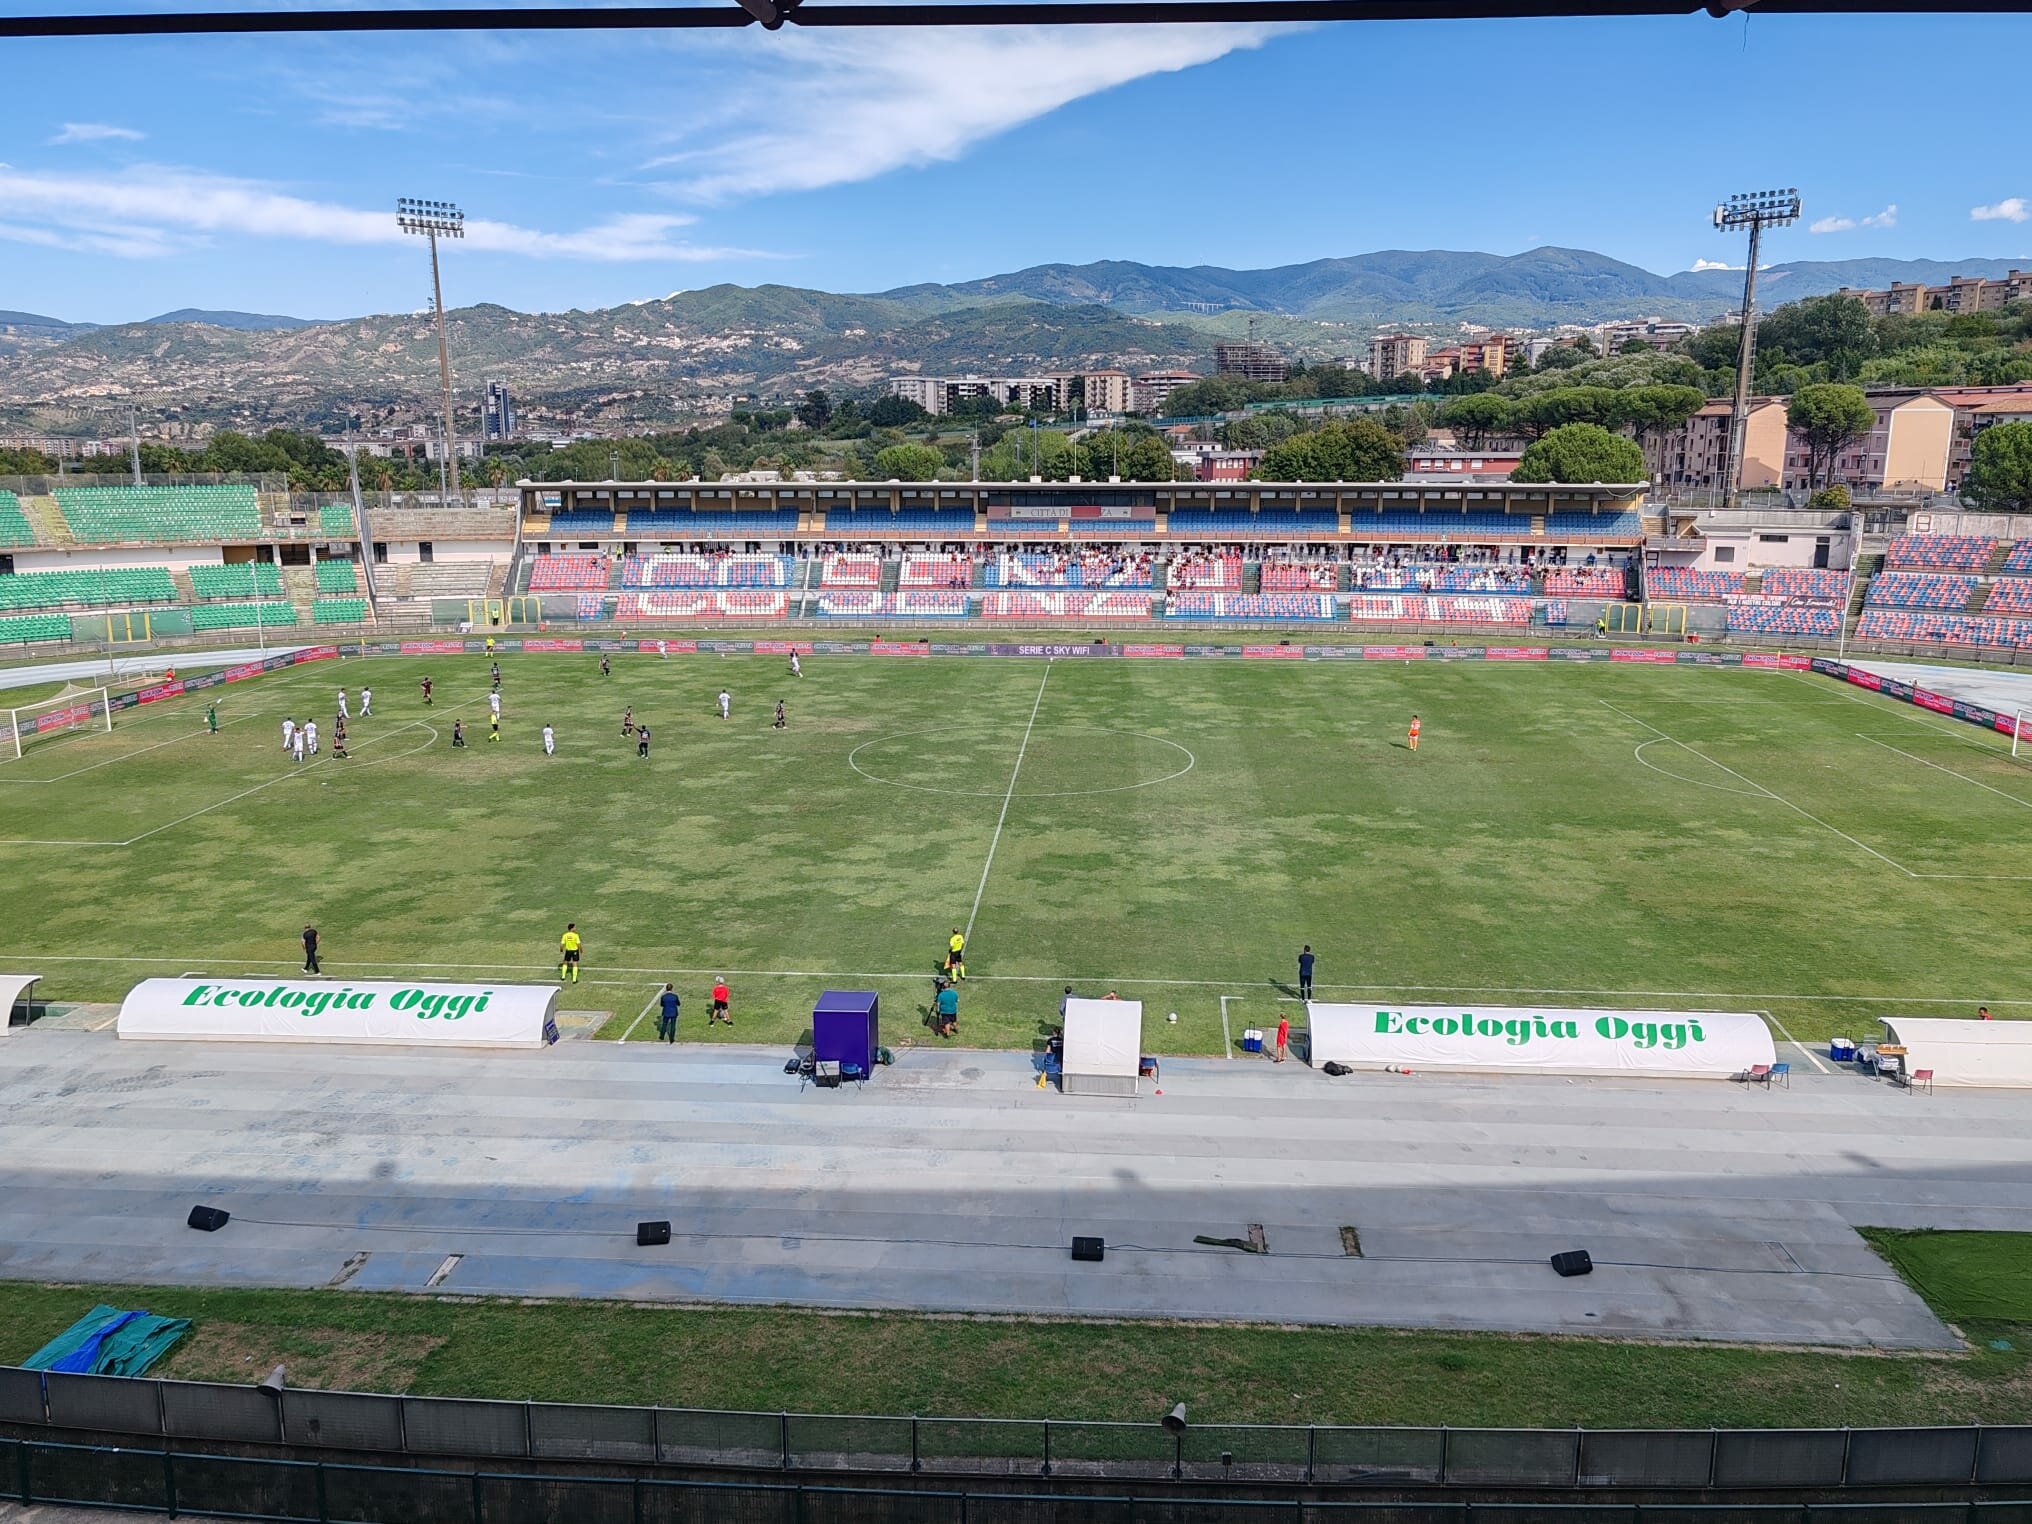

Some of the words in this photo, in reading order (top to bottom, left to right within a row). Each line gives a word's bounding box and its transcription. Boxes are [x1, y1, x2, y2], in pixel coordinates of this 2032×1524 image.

[1019, 646, 1043, 654] SERIE
[1045, 646, 1052, 654] C
[1054, 646, 1070, 654] SKY
[1072, 646, 1089, 655] WIFI
[182, 985, 376, 1017] Ecologia
[388, 988, 493, 1020] Oggi
[1375, 1011, 1579, 1045] Ecologia
[1595, 1016, 1706, 1049] Oggi
